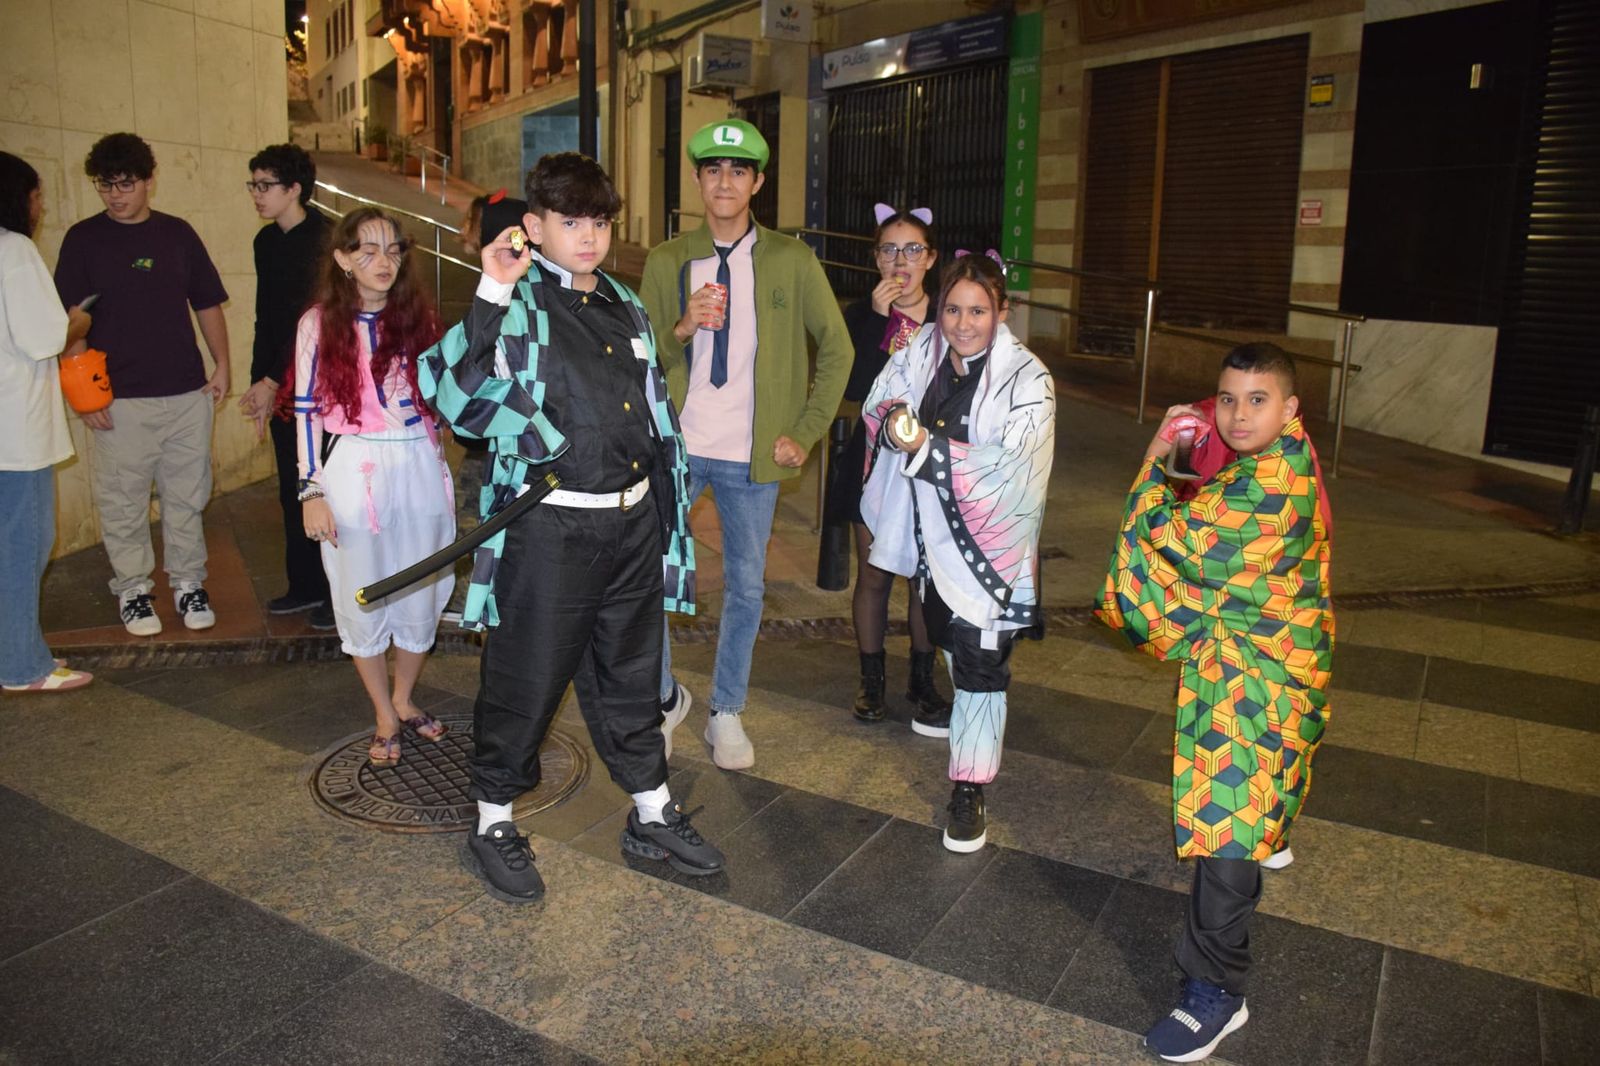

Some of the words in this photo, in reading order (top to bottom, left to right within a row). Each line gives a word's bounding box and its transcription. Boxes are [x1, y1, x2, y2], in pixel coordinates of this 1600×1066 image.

[722, 127, 735, 144] L
[342, 795, 474, 822] NACIONAL
[1169, 1008, 1202, 1033] PUMA
